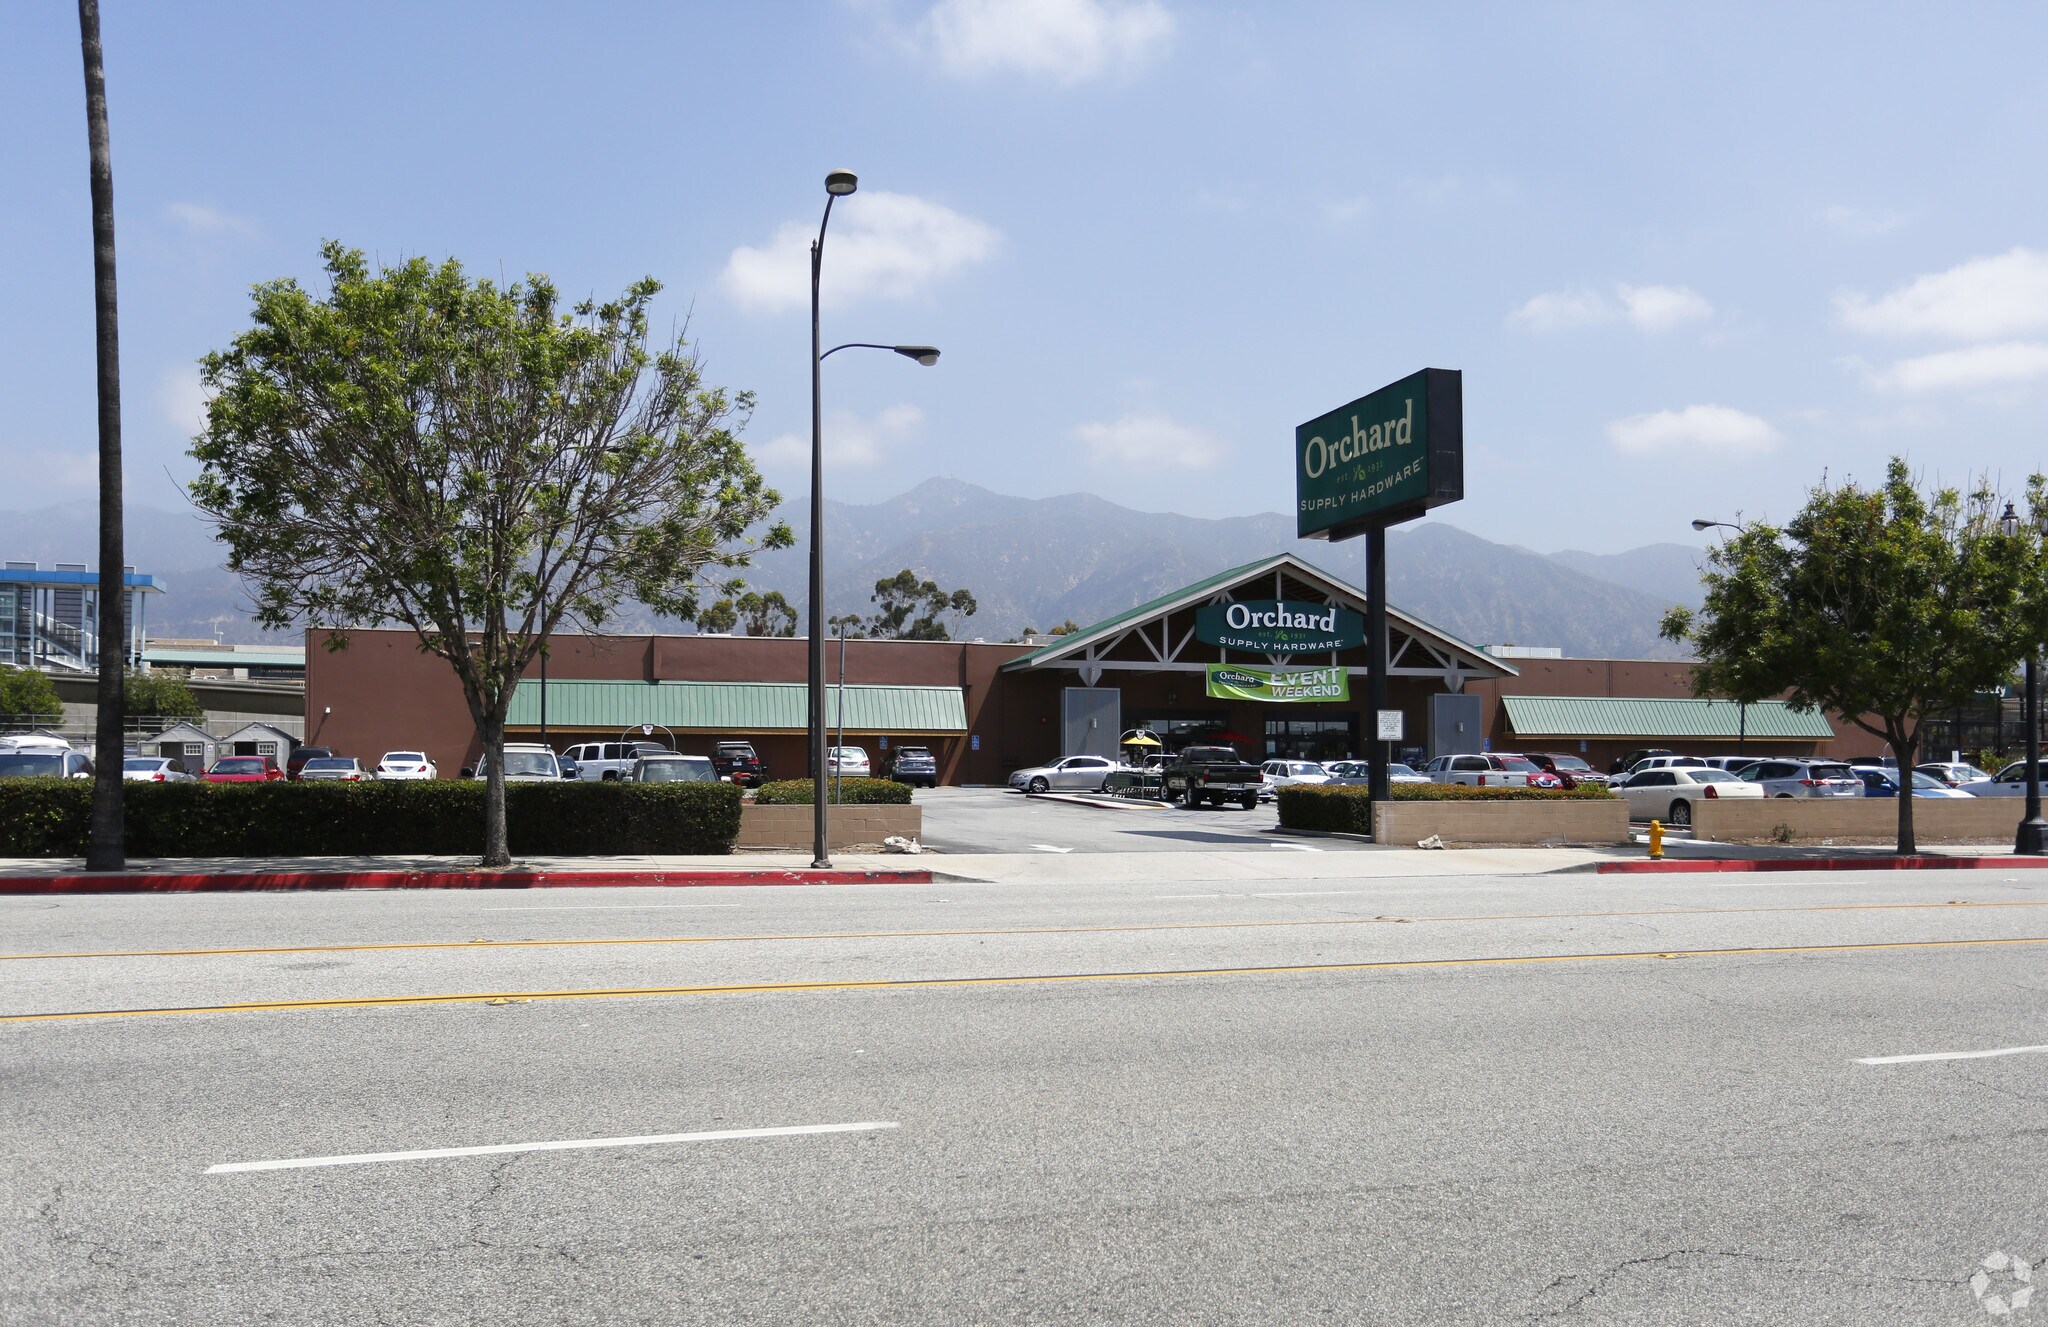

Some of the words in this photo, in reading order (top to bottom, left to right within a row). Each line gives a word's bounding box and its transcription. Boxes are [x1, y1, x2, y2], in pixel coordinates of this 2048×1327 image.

[1305, 399, 1413, 479] Orchard
[1300, 494, 1346, 511] SUPPLY
[1351, 459, 1421, 503] HARDWARE
[1226, 602, 1336, 633] Orchard
[1219, 636, 1268, 650] SUPPLY
[1273, 639, 1341, 650] HARDWARE
[1270, 668, 1340, 686] EVENT
[1272, 684, 1341, 697] WEEKEND
